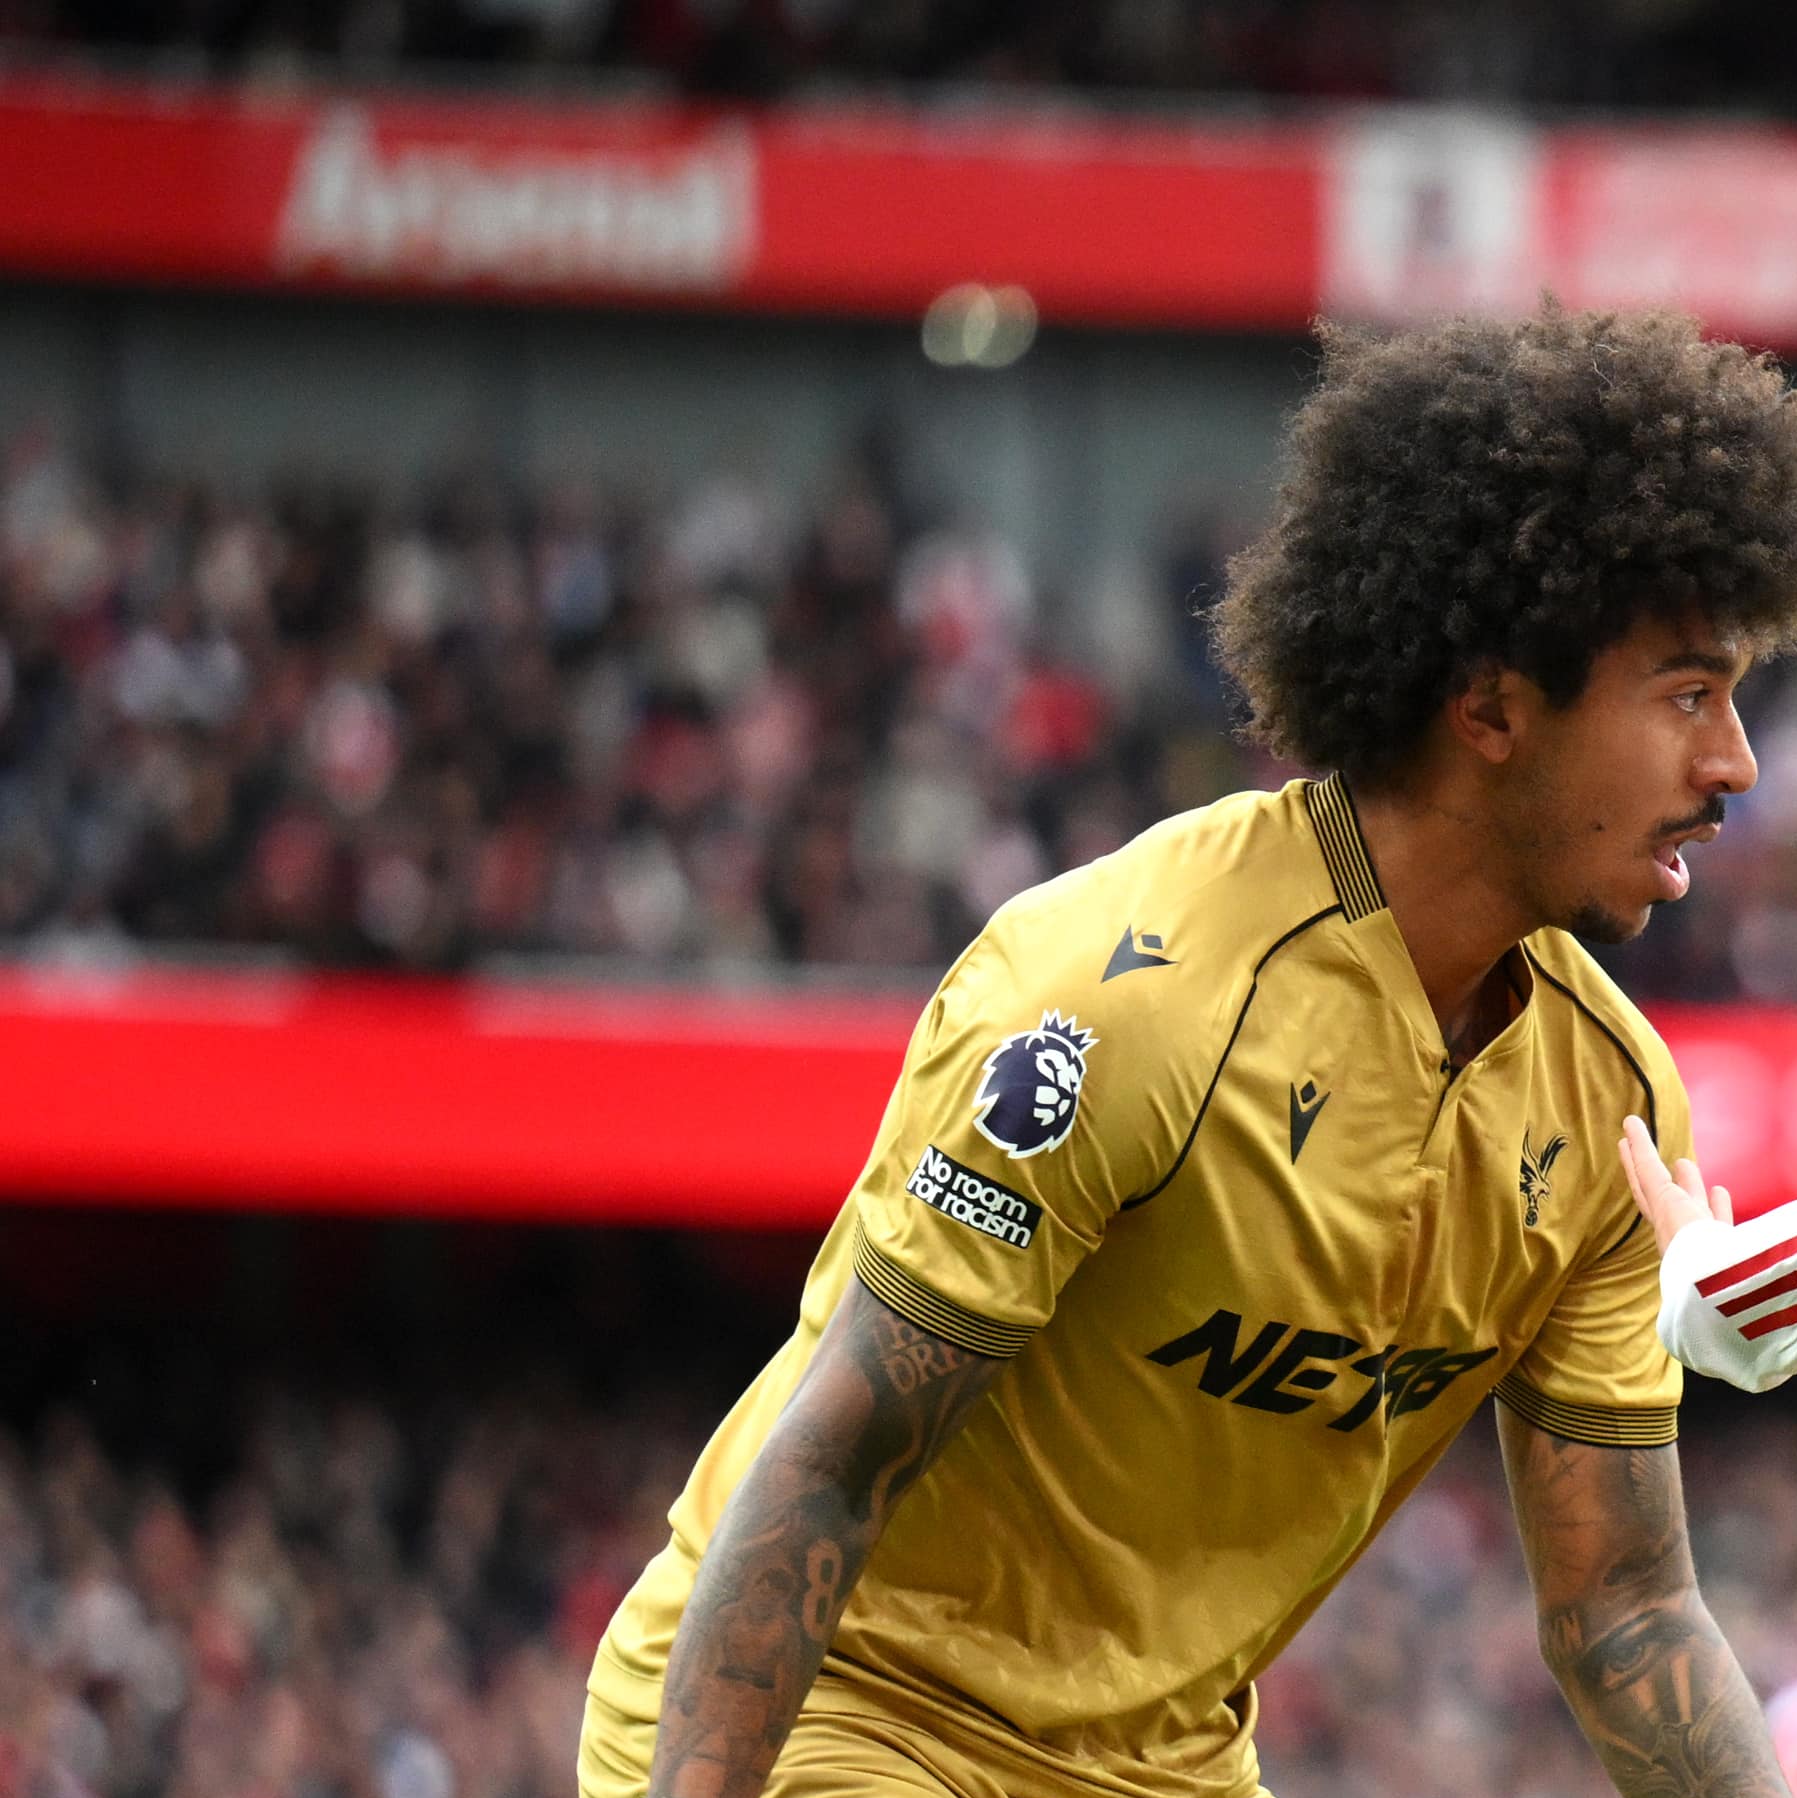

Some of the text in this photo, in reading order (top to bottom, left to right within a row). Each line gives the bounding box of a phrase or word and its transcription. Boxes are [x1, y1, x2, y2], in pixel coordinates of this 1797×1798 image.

[907, 1168, 1032, 1248] for racism
[918, 1146, 1028, 1221] No room
